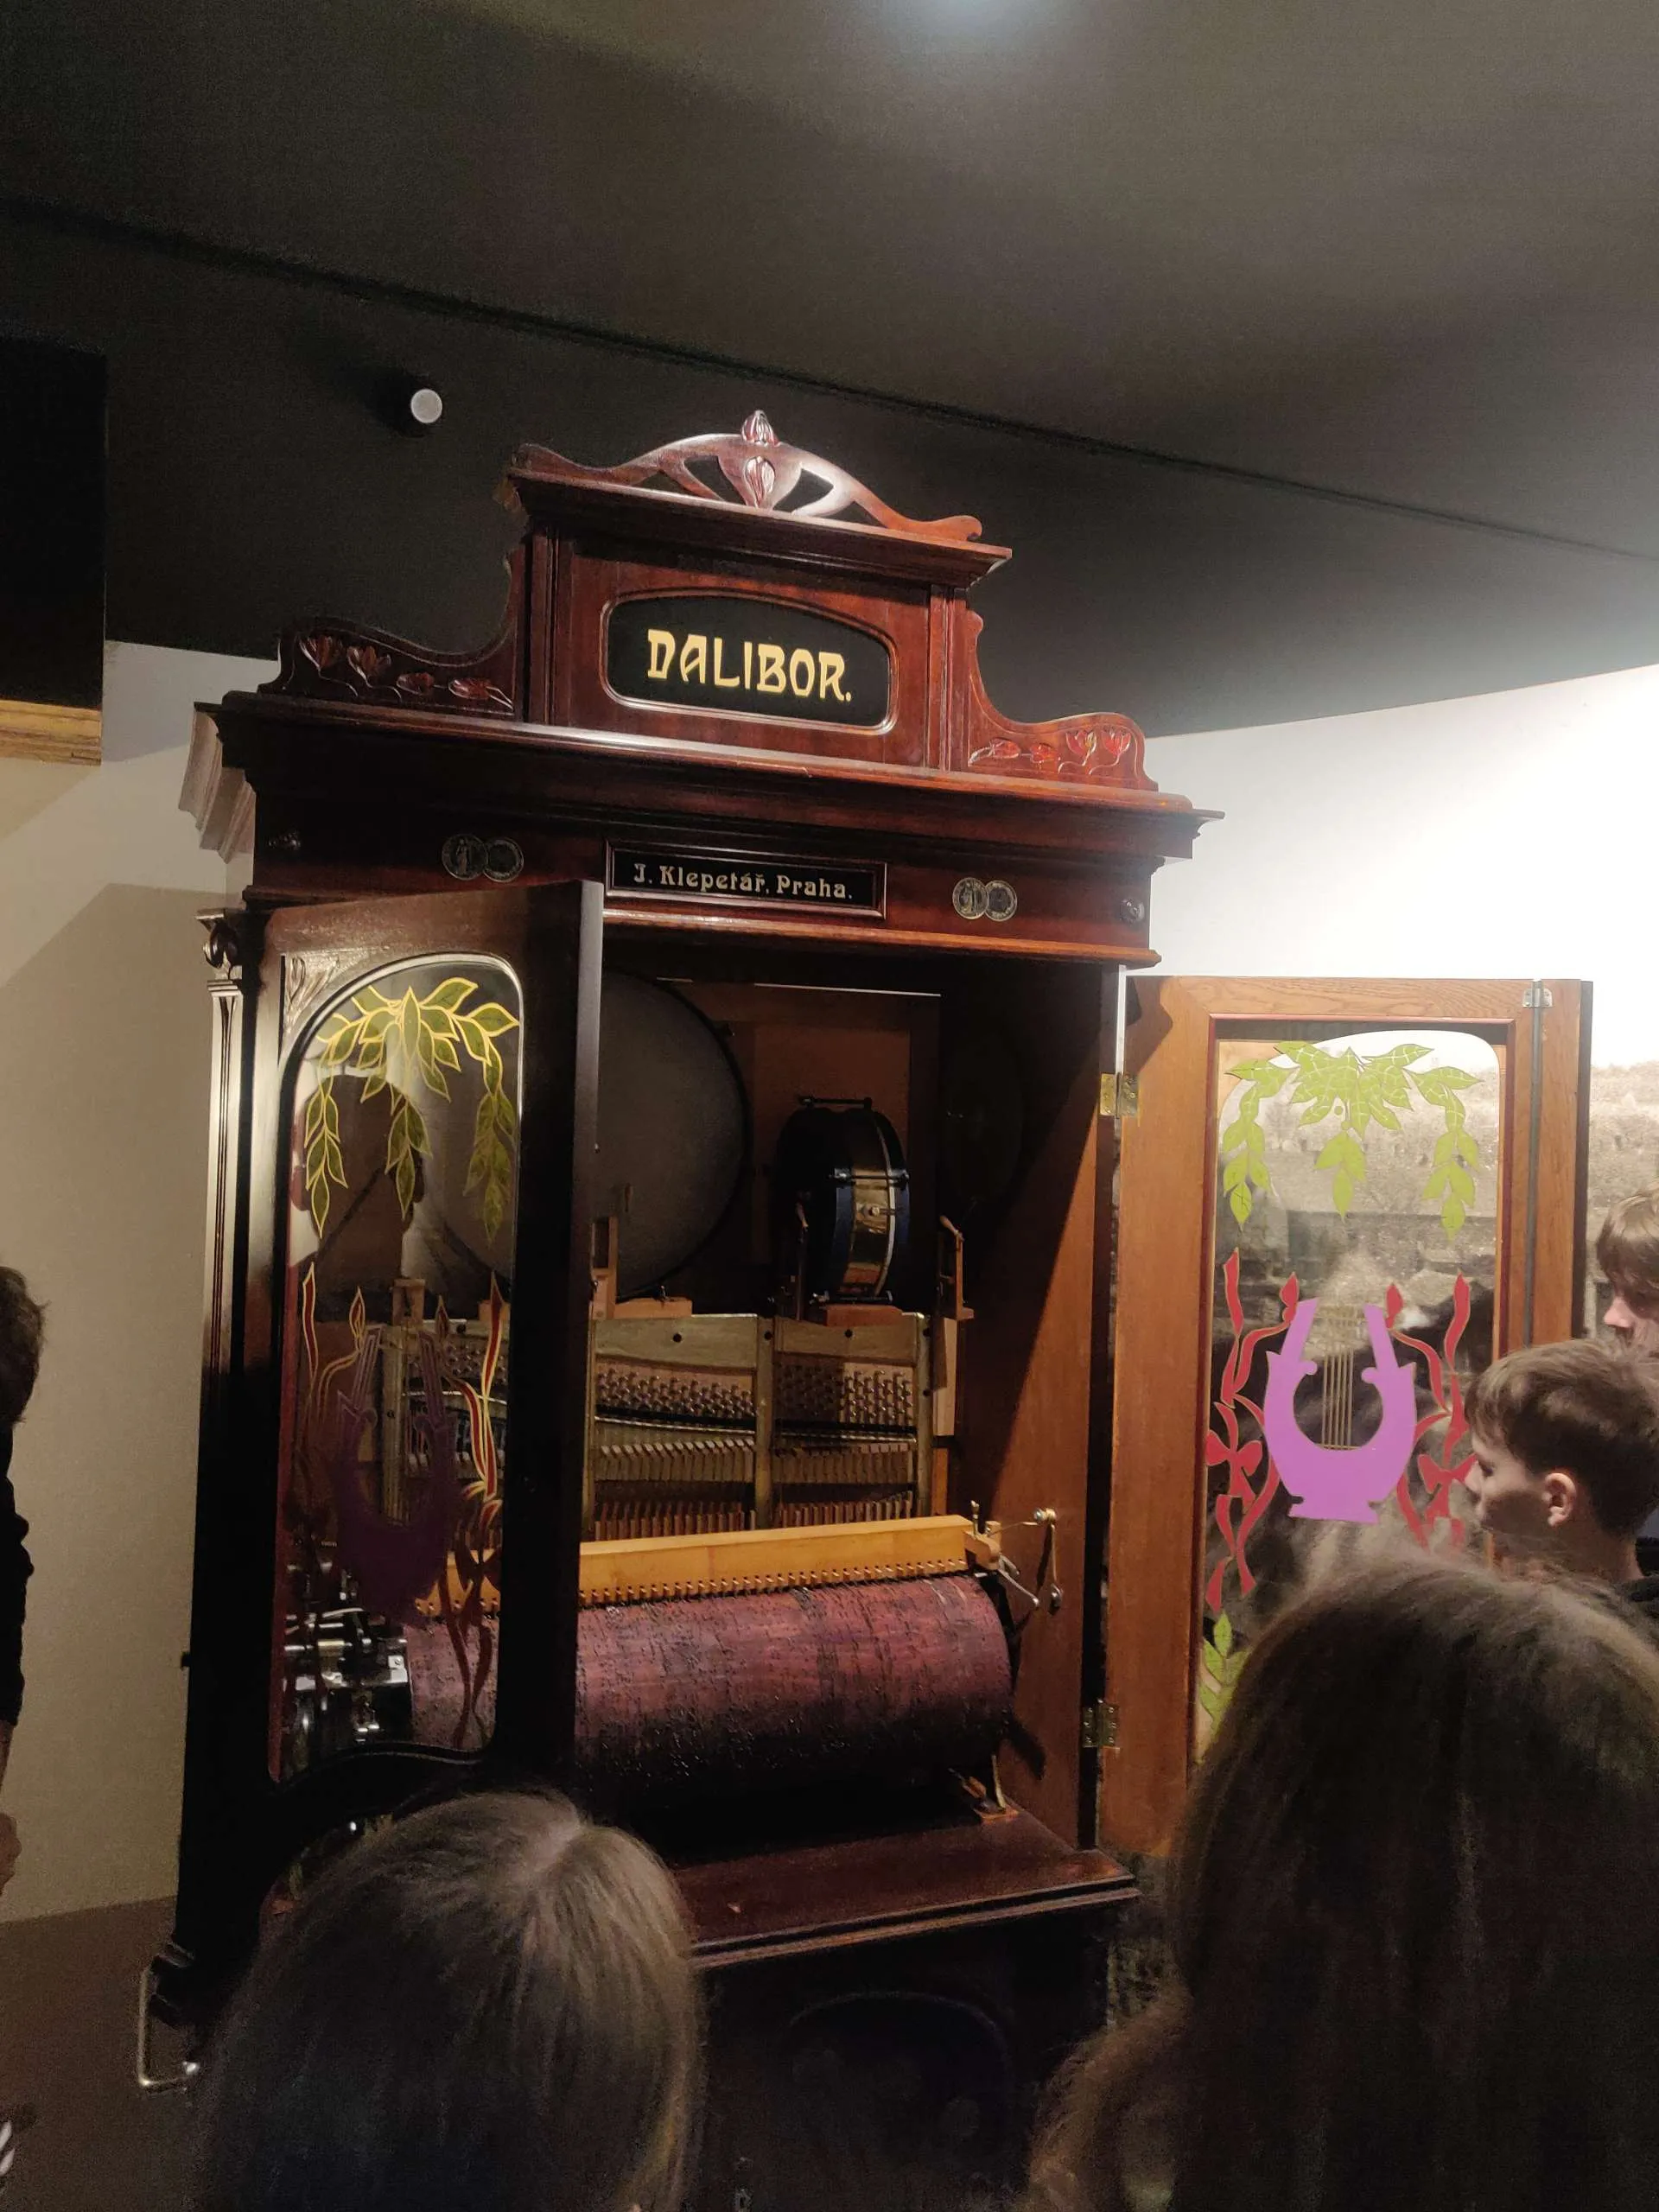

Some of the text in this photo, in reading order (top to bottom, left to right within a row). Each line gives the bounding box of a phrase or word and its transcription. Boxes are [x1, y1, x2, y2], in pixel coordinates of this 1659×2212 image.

[647, 628, 852, 702] DALIBOR.
[633, 863, 652, 884] J.
[776, 874, 853, 899] Praha.
